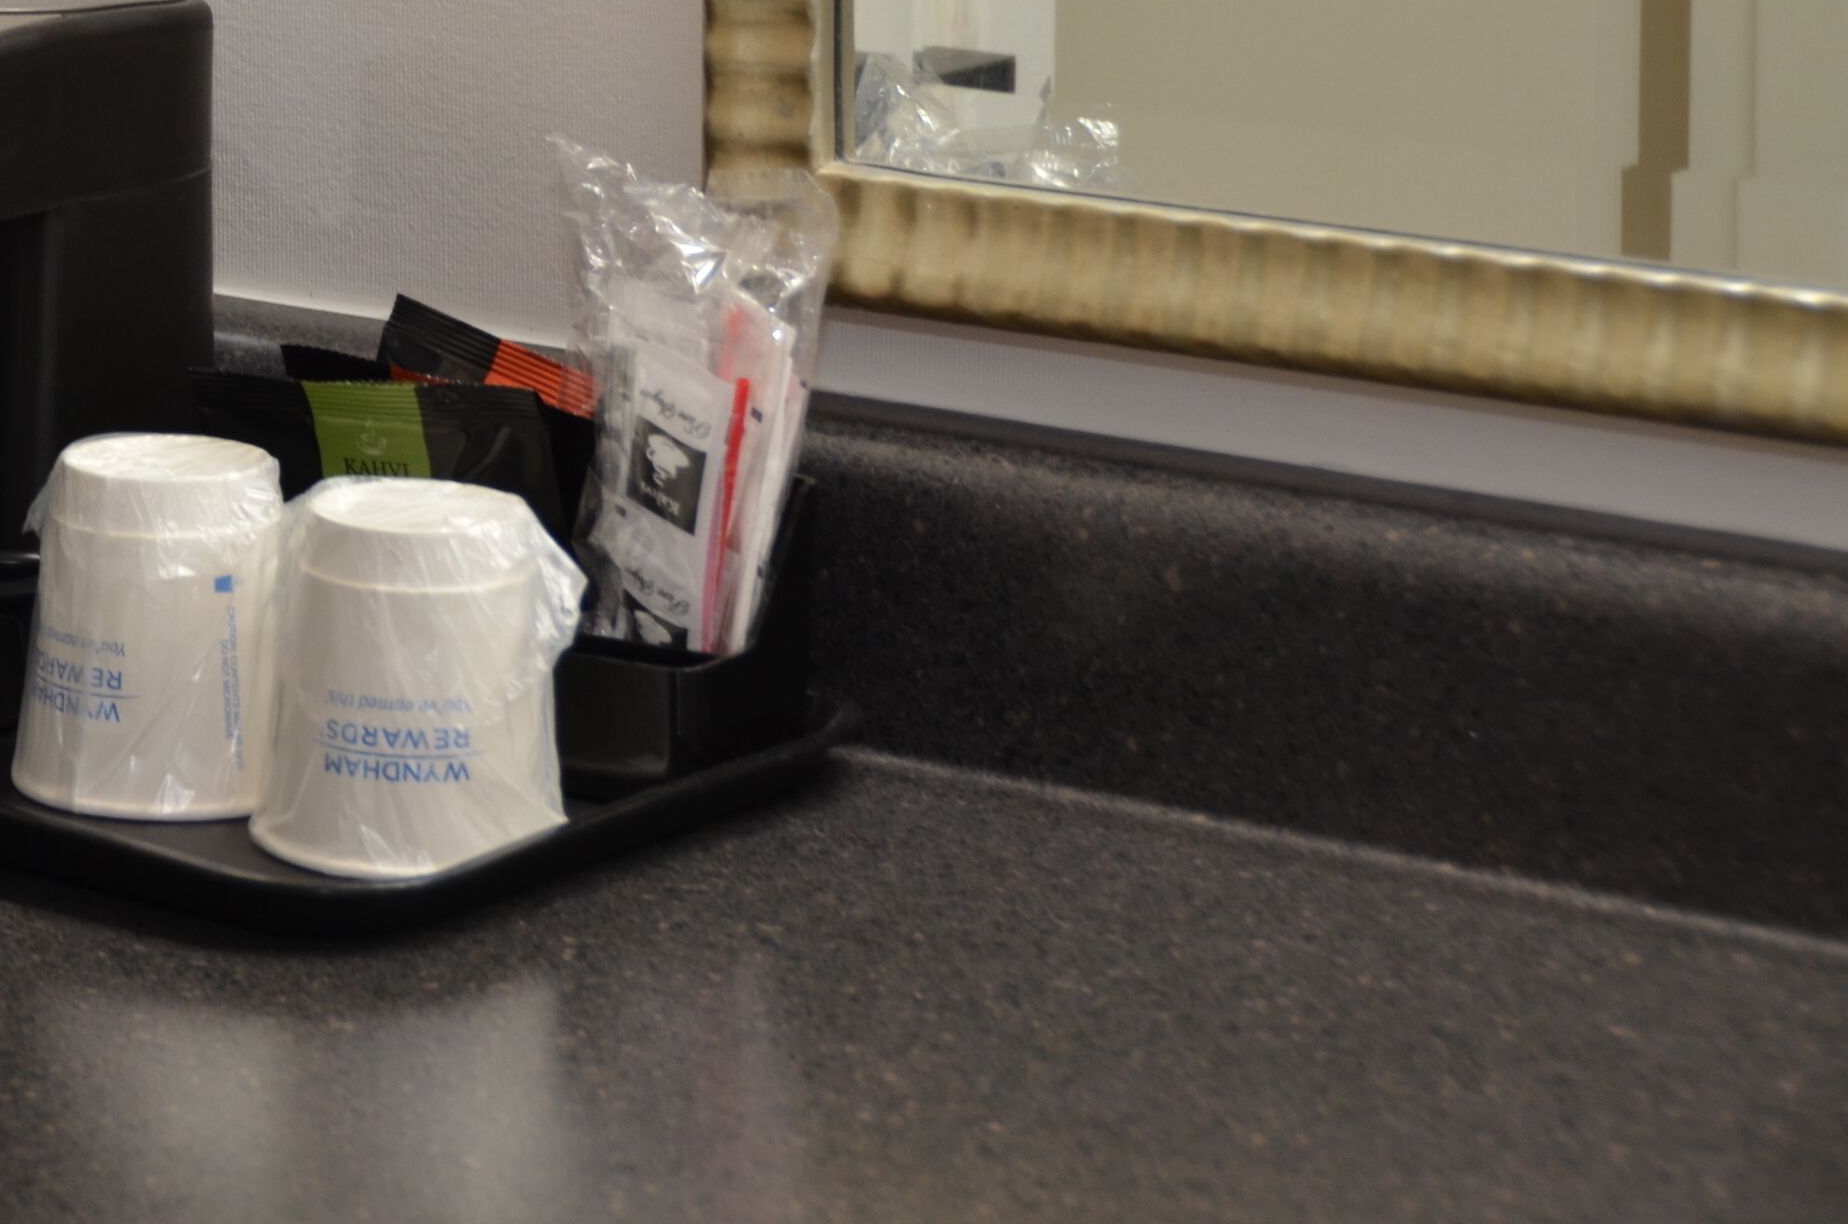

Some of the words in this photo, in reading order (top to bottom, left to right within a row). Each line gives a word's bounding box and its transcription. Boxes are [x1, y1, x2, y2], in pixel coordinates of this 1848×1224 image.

[344, 457, 408, 476] KAHVI
[358, 695, 414, 710] earned
[326, 719, 470, 749] REWARDS
[324, 752, 471, 782] WYNDHAM
